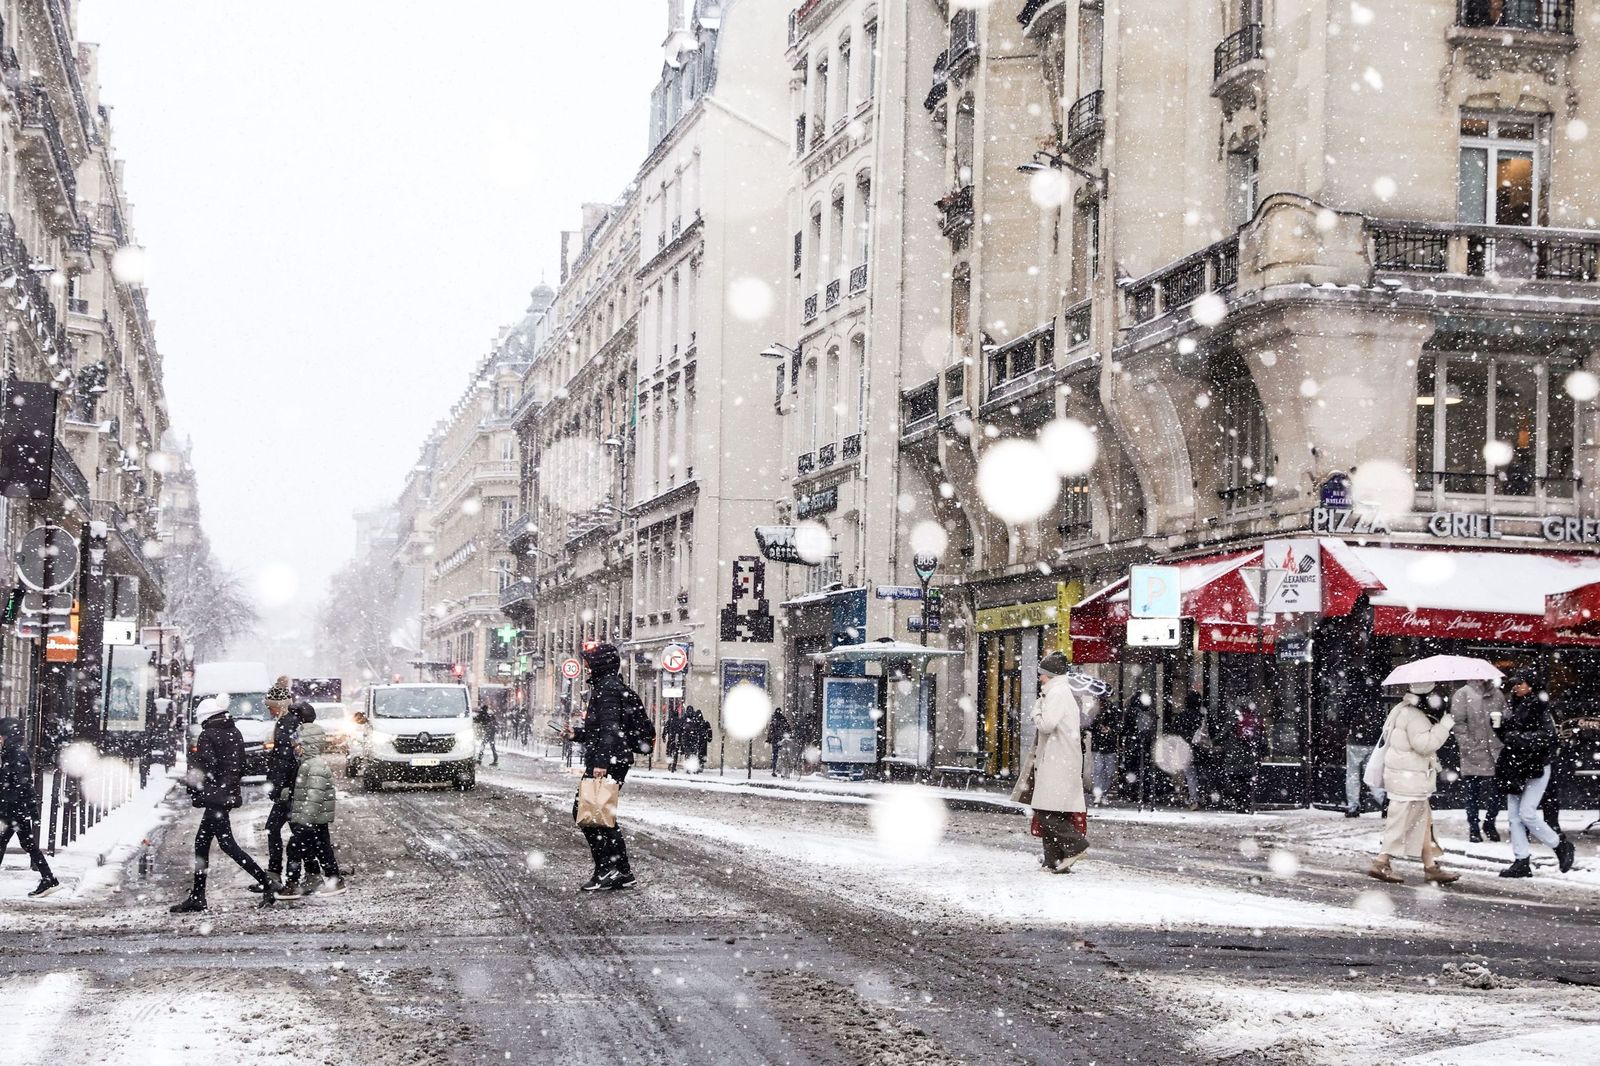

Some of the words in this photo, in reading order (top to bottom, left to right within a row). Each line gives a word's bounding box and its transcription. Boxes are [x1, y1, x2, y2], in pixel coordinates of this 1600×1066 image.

[1312, 507, 1392, 535] PIZZA
[1428, 510, 1502, 539] GRILL
[917, 553, 935, 566] BUS
[1147, 576, 1167, 606] P
[1446, 614, 1482, 631] London
[566, 664, 577, 673] 30
